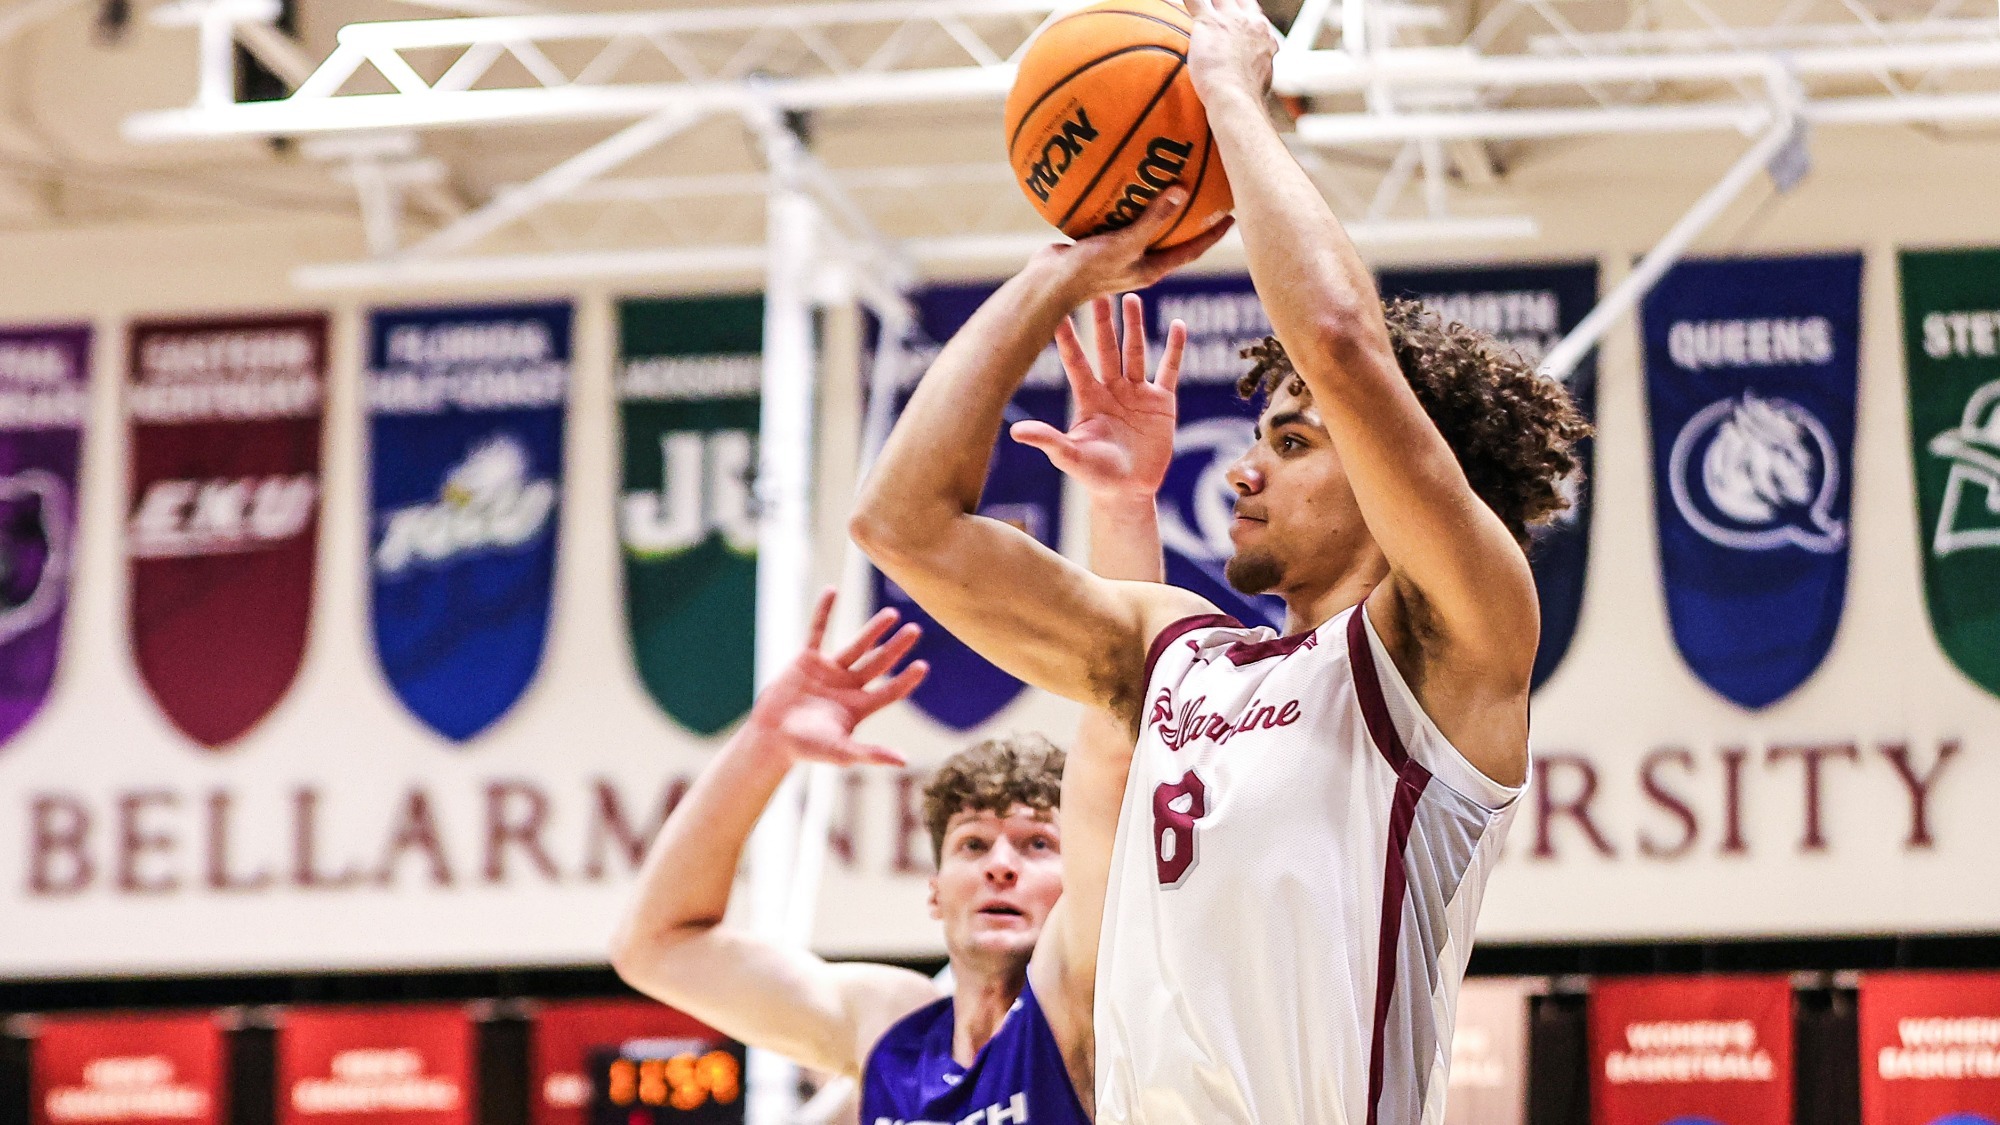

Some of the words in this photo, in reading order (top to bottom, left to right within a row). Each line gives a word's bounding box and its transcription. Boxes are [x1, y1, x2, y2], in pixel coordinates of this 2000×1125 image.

[1025, 106, 1099, 204] NCAA
[1156, 293, 1266, 332] NORT
[1669, 317, 1834, 368] QUEENS
[132, 475, 318, 546] EKU
[26, 768, 934, 896] BELLARMNE
[1153, 765, 1213, 892] 8
[1531, 738, 1963, 862] RSITY
[1605, 1048, 1775, 1084] BASKETBALL
